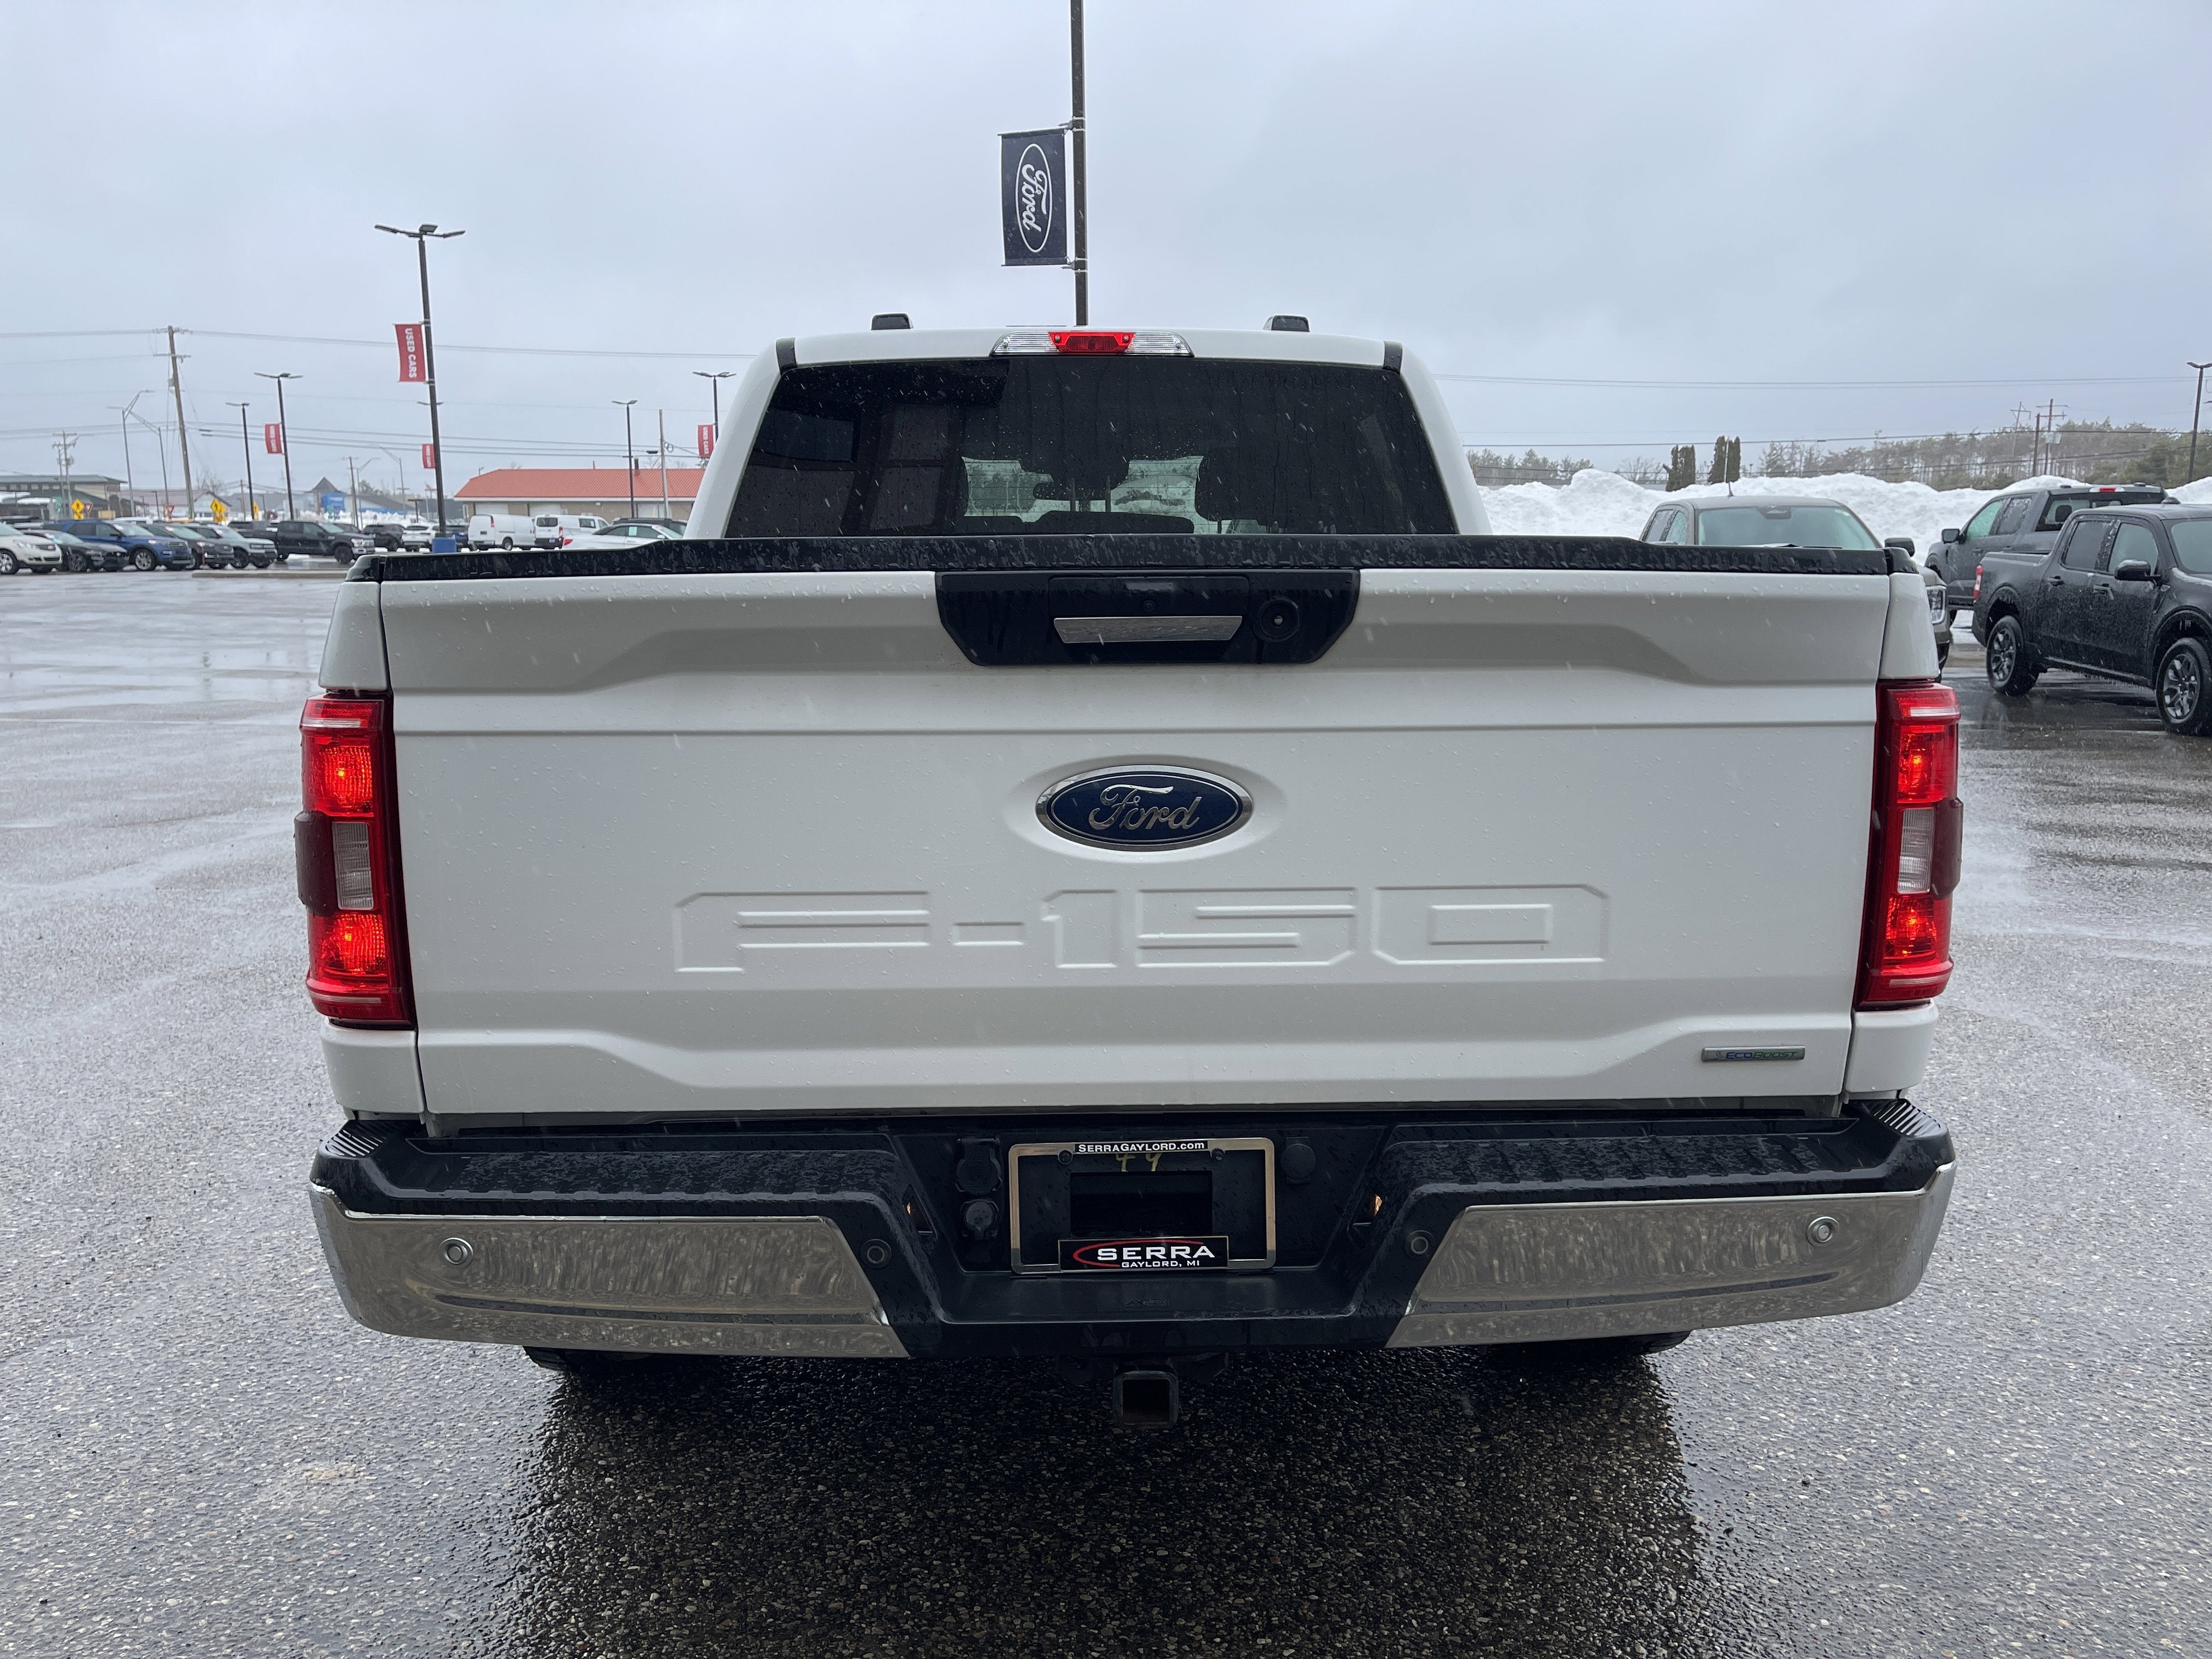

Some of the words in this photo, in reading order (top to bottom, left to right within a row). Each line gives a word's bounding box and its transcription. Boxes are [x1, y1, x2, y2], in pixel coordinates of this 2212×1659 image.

[1022, 163, 1047, 232] Ford
[405, 328, 415, 352] USED
[408, 354, 417, 379] CARS
[1088, 784, 1202, 830] Ford
[672, 884, 1610, 973] F-150
[1097, 1245, 1215, 1261] SERRA
